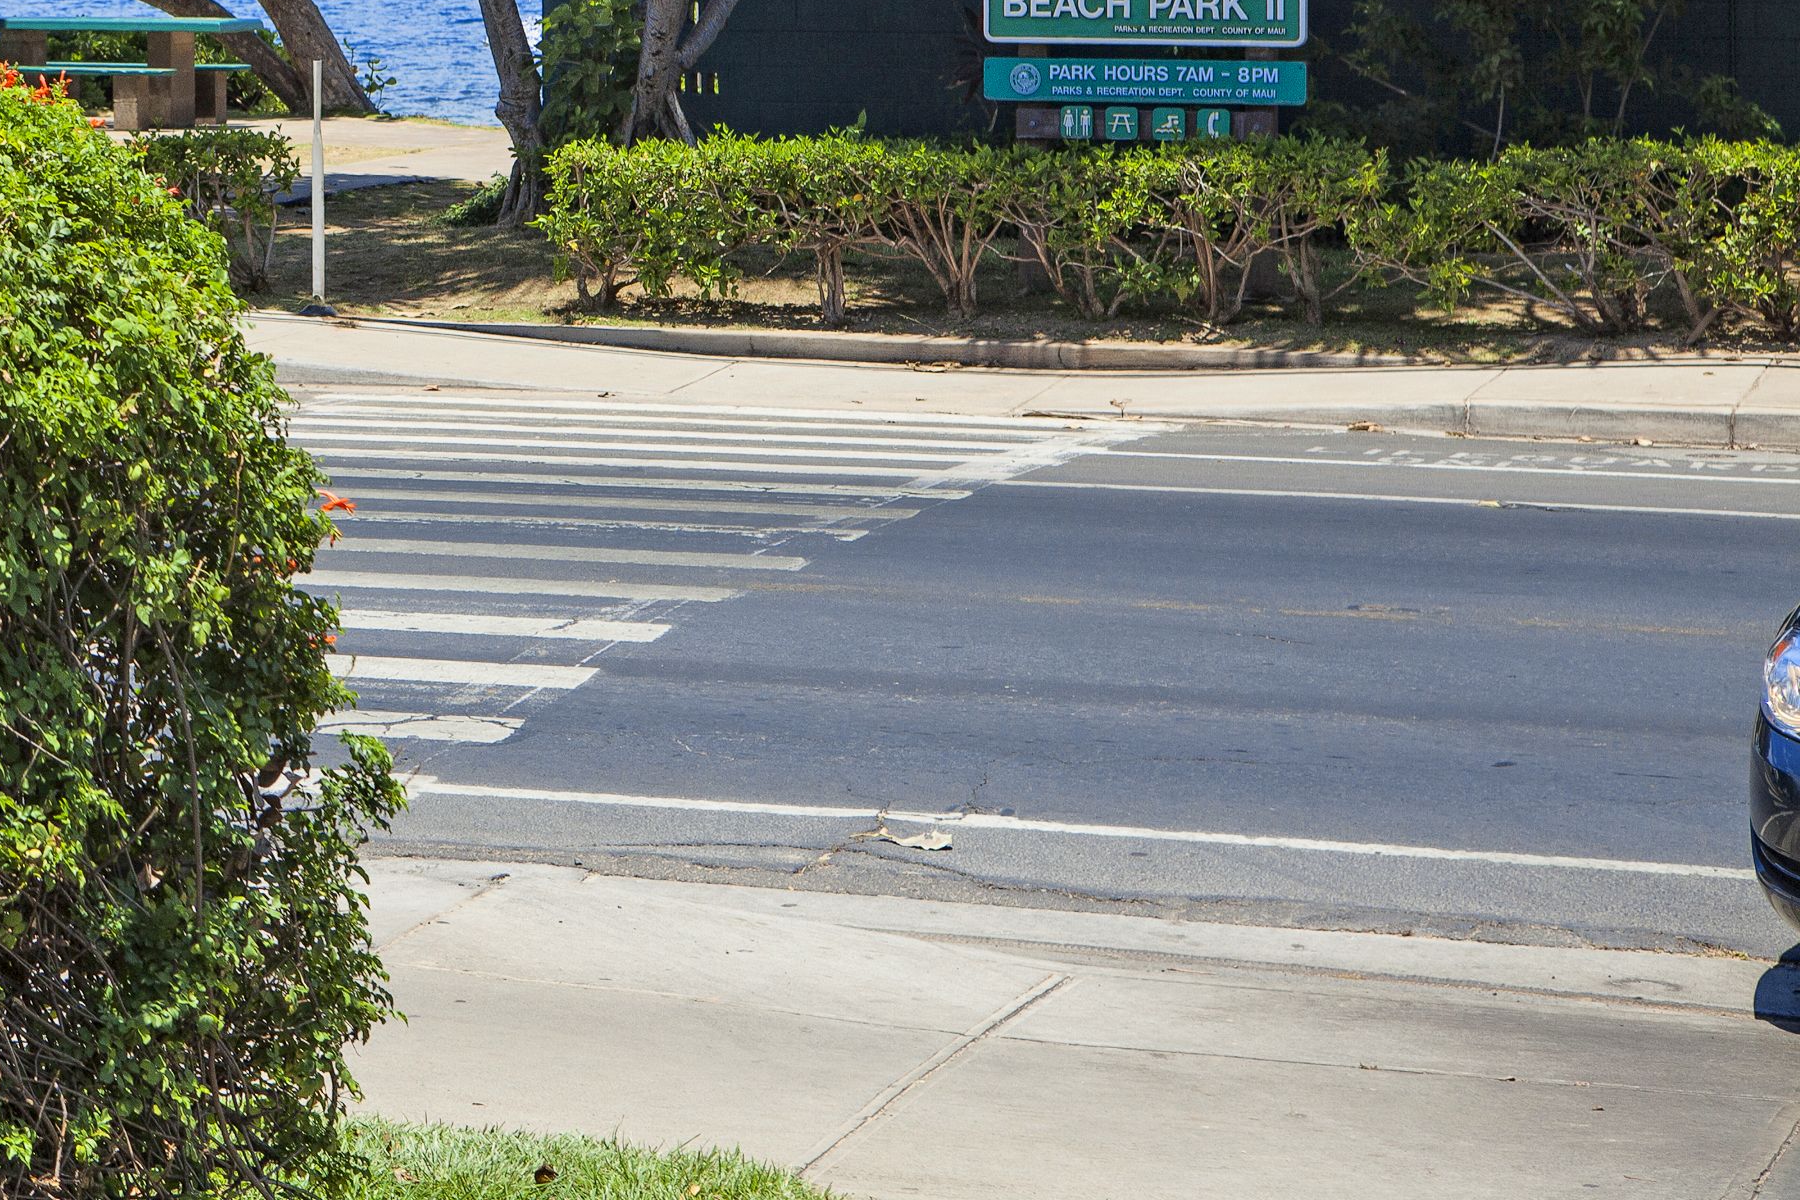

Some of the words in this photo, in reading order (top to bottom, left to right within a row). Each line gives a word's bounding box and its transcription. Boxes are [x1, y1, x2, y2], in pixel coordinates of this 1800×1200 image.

[1148, 25, 1194, 35] RECREATION
[1221, 26, 1253, 35] COUNTY
[1254, 27, 1265, 35] OF
[1267, 27, 1286, 36] MAUI
[1049, 64, 1096, 80] PARK
[1104, 64, 1169, 82] HOURS
[1176, 66, 1214, 82] 7AM
[1238, 67, 1279, 83] 8PM
[1051, 85, 1083, 95] PARKS
[1085, 86, 1093, 95] &
[1096, 86, 1156, 97] RECREATION
[1158, 87, 1185, 97] DEPT.
[1192, 88, 1233, 98] COUNTY
[1235, 88, 1249, 98] OF
[1252, 88, 1276, 99] MAUI
